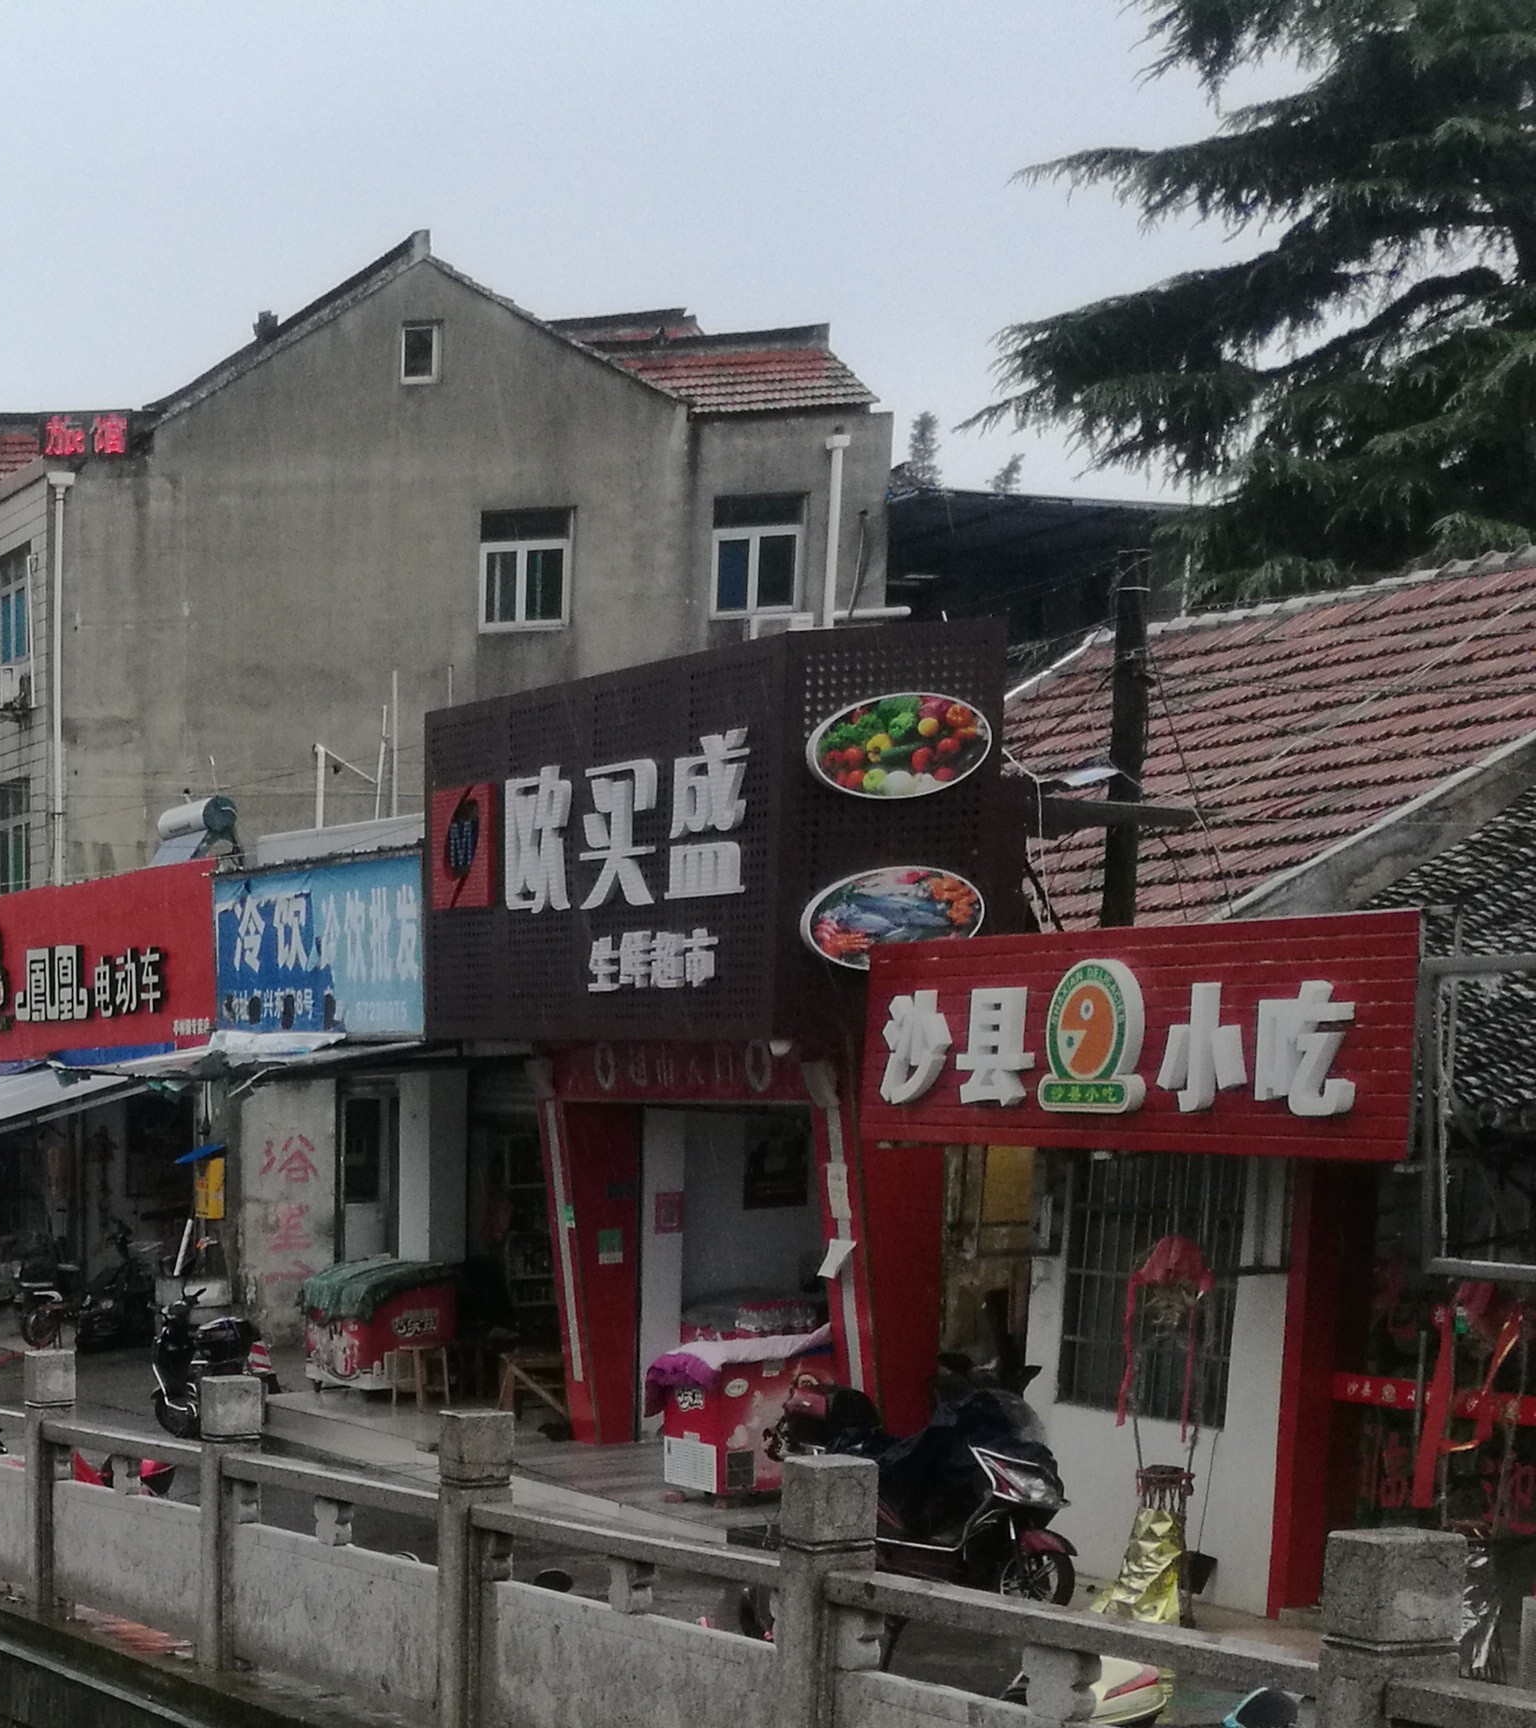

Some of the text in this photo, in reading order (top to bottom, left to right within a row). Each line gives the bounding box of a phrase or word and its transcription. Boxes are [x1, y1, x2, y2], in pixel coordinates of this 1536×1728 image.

[587, 927, 719, 992] 生鲜超市
[880, 980, 1356, 1117] 沙县 小吃
